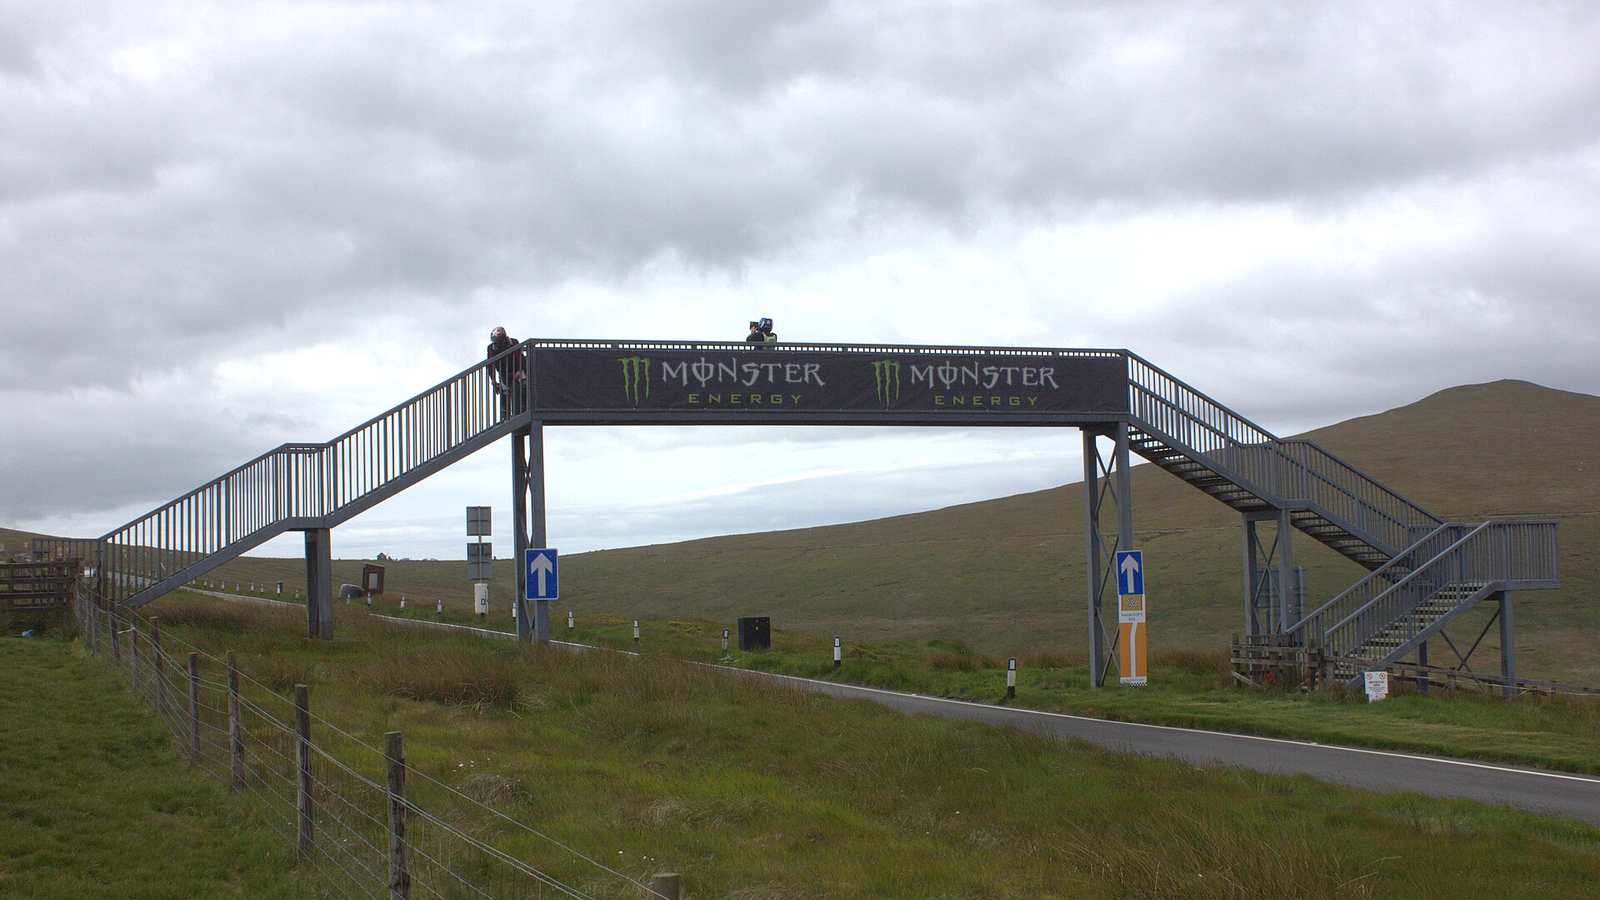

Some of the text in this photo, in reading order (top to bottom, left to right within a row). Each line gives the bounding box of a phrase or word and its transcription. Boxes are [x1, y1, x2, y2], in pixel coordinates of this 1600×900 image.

[661, 357, 825, 387] MONSTER
[911, 361, 1060, 389] MONSTER
[688, 393, 802, 404] ENERGY
[935, 395, 1039, 406] ENERGY
